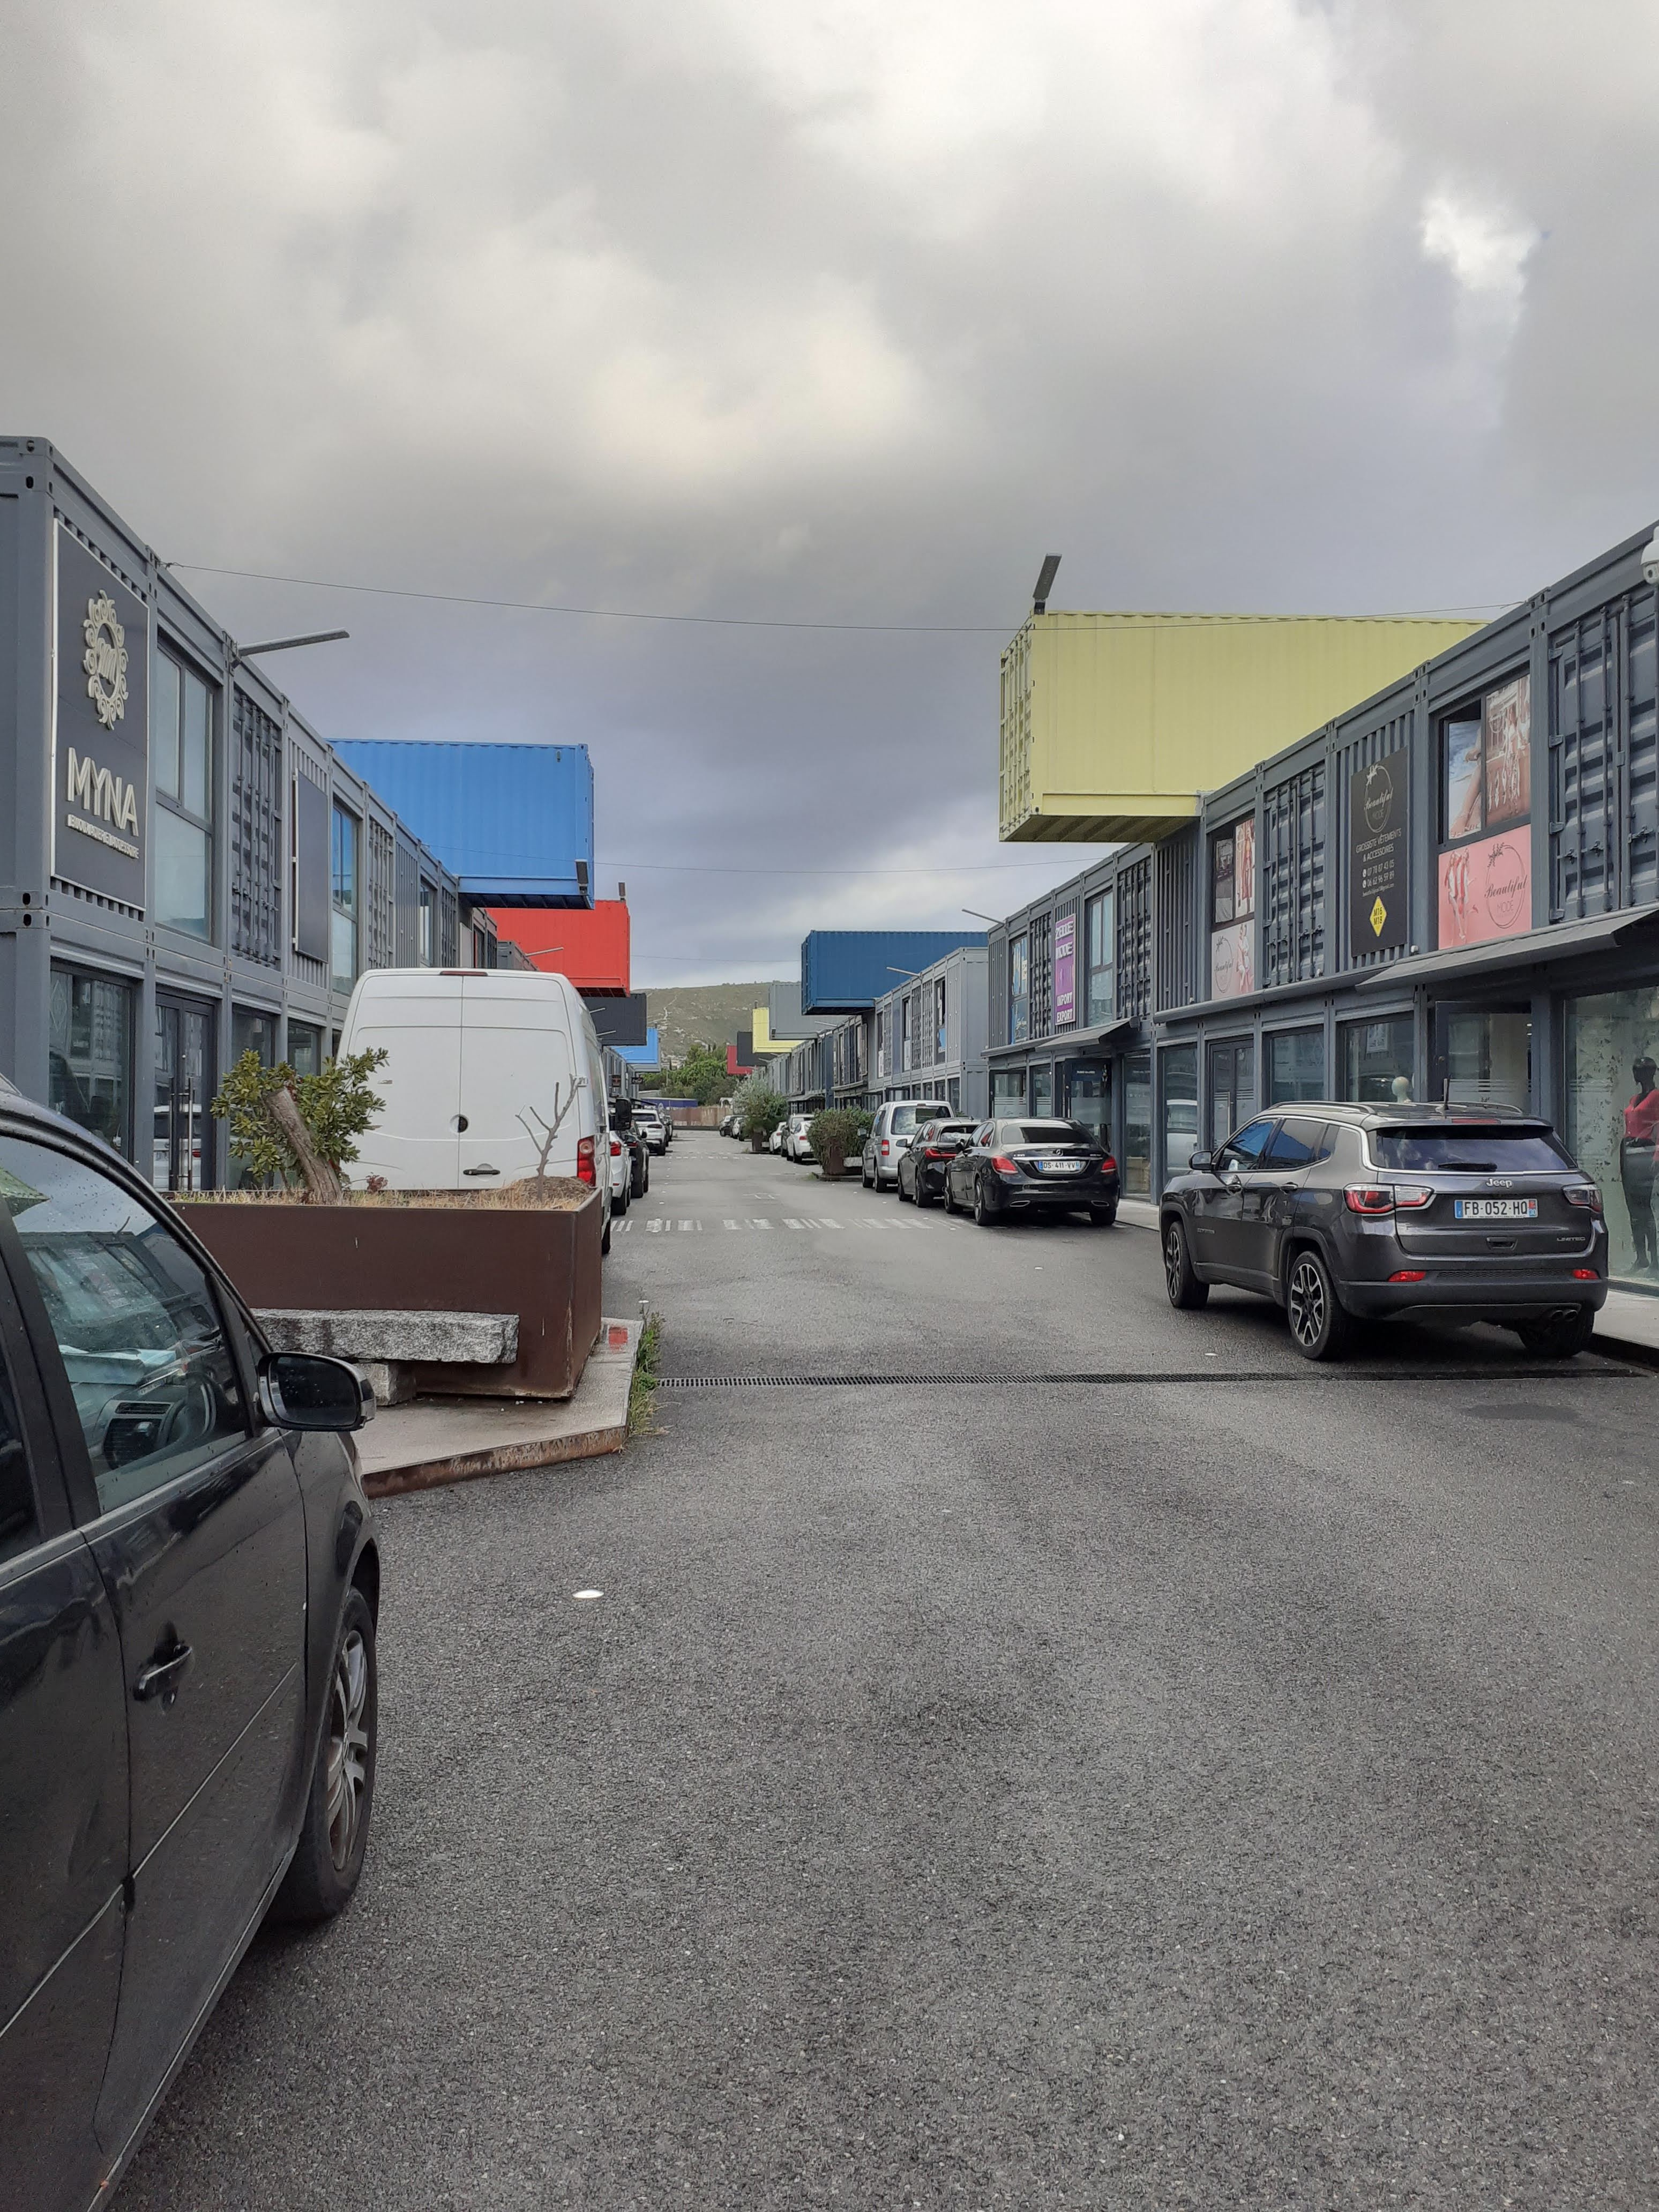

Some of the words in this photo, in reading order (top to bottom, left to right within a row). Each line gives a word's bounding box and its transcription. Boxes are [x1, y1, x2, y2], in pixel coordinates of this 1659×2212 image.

[68, 747, 139, 836] MYNA
[1364, 787, 1393, 811] Beautiful
[1356, 838, 1377, 853] GROSSISTE
[1367, 843, 1394, 861] ACCESSOIRES
[1484, 875, 1528, 898] Beautiful
[1056, 941, 1073, 960] MODE
[1057, 992, 1072, 1006] IMPORT
[1057, 1008, 1072, 1023] EXPORT
[1486, 1178, 1512, 1188] Jeep
[1464, 1201, 1527, 1215] FB-052-HQ
